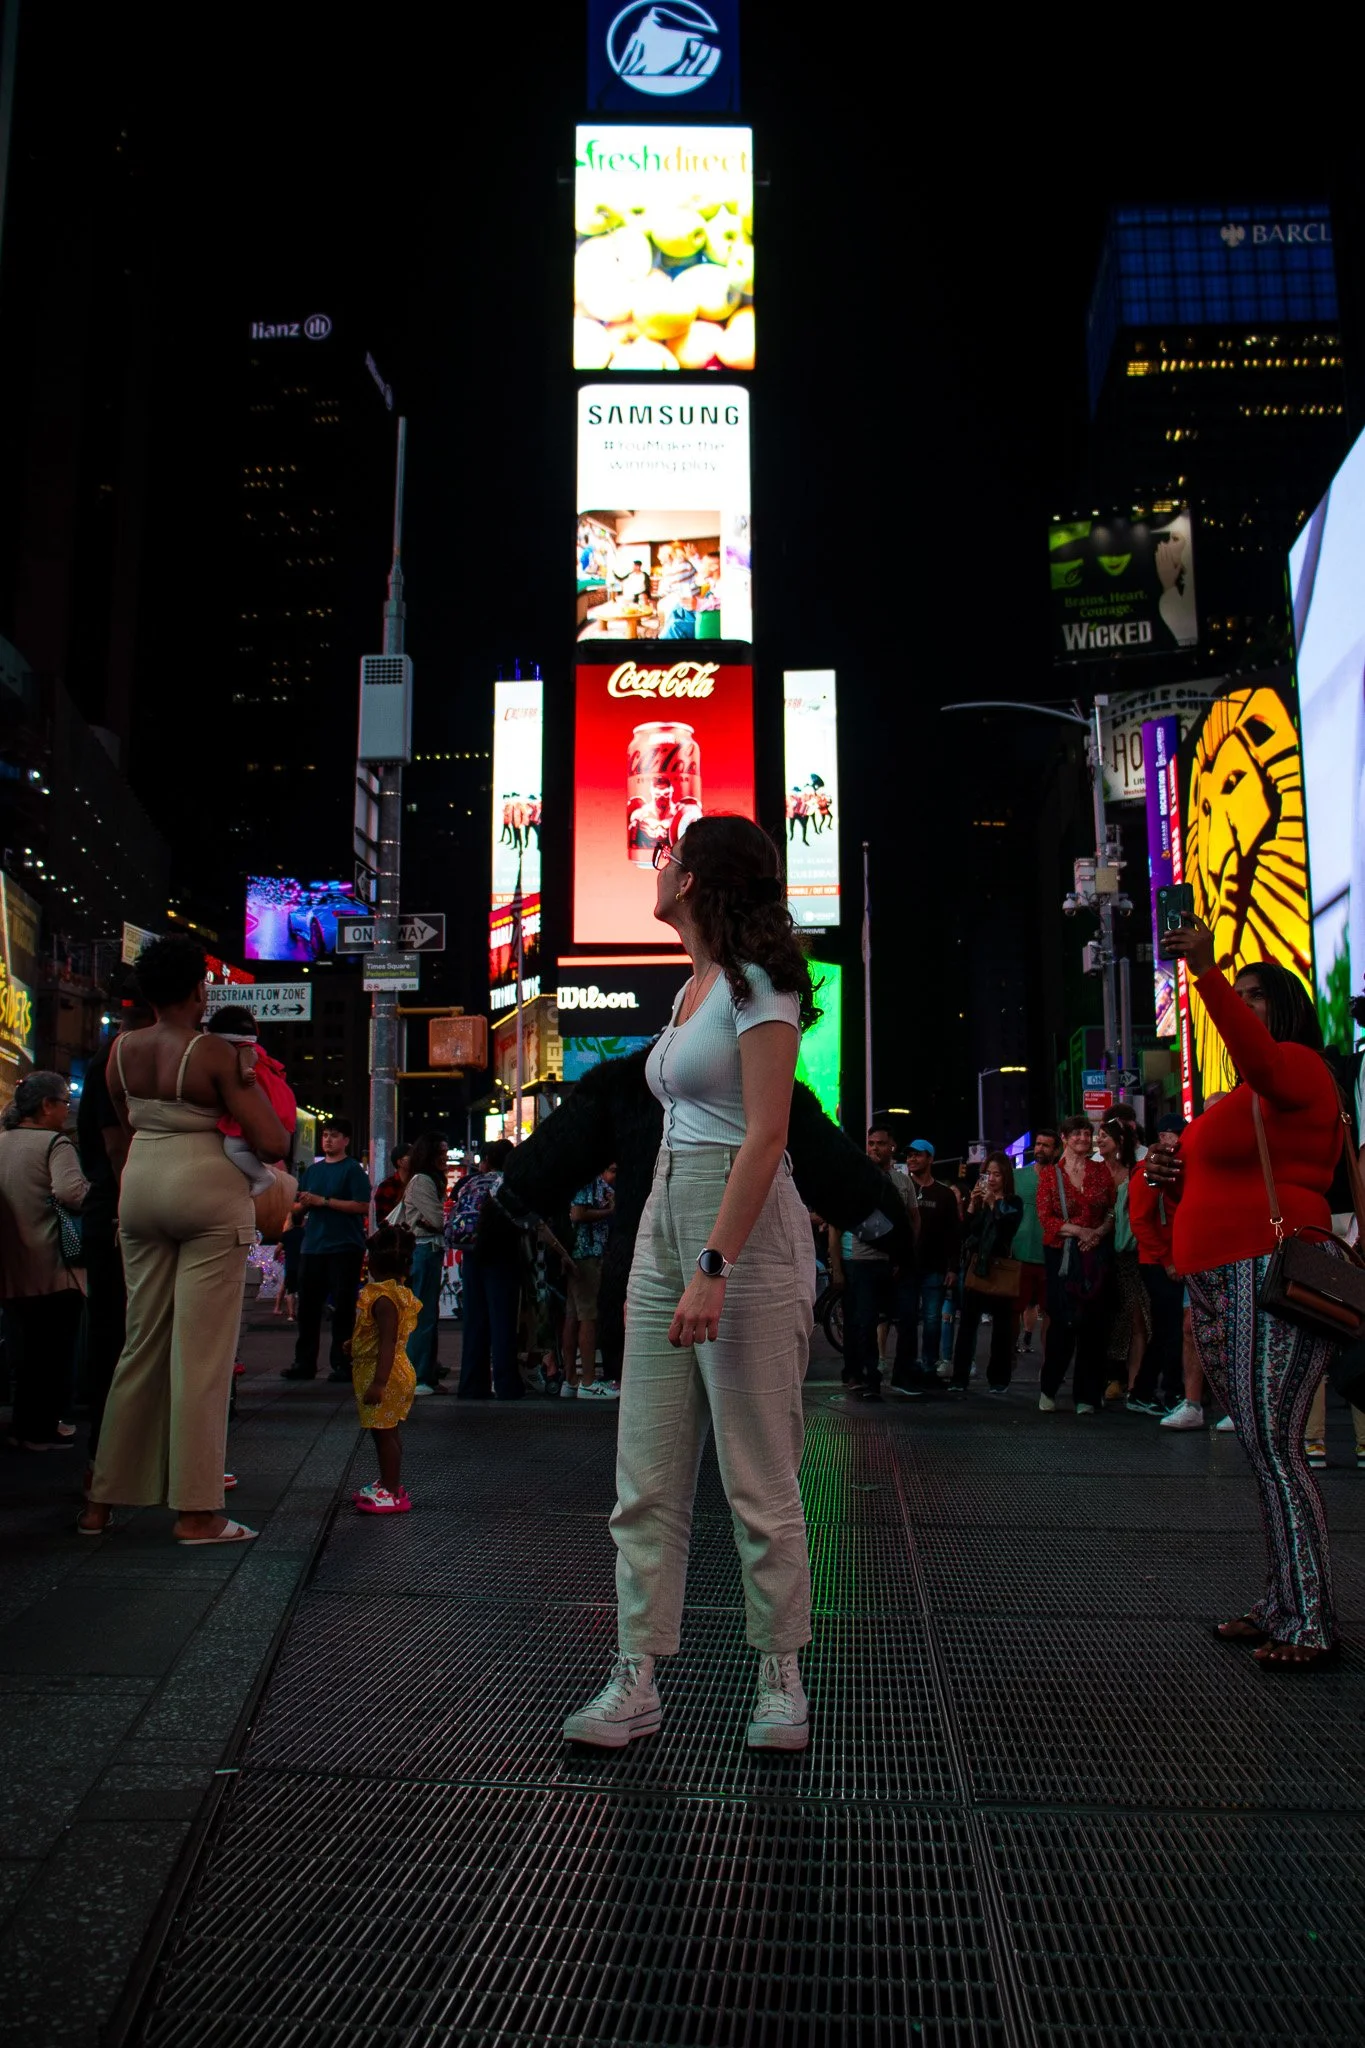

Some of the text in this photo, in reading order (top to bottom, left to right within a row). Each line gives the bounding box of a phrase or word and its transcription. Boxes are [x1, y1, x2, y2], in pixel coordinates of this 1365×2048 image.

[584, 139, 748, 173] freshdirect
[587, 404, 741, 426] SAMSUNG
[1062, 620, 1153, 650] WICKED
[607, 661, 720, 698] Coca-Cola
[367, 962, 411, 971] Times Square
[256, 988, 280, 1001] FLOW
[283, 987, 306, 1000] ZONE
[557, 985, 637, 1010] Wilson
